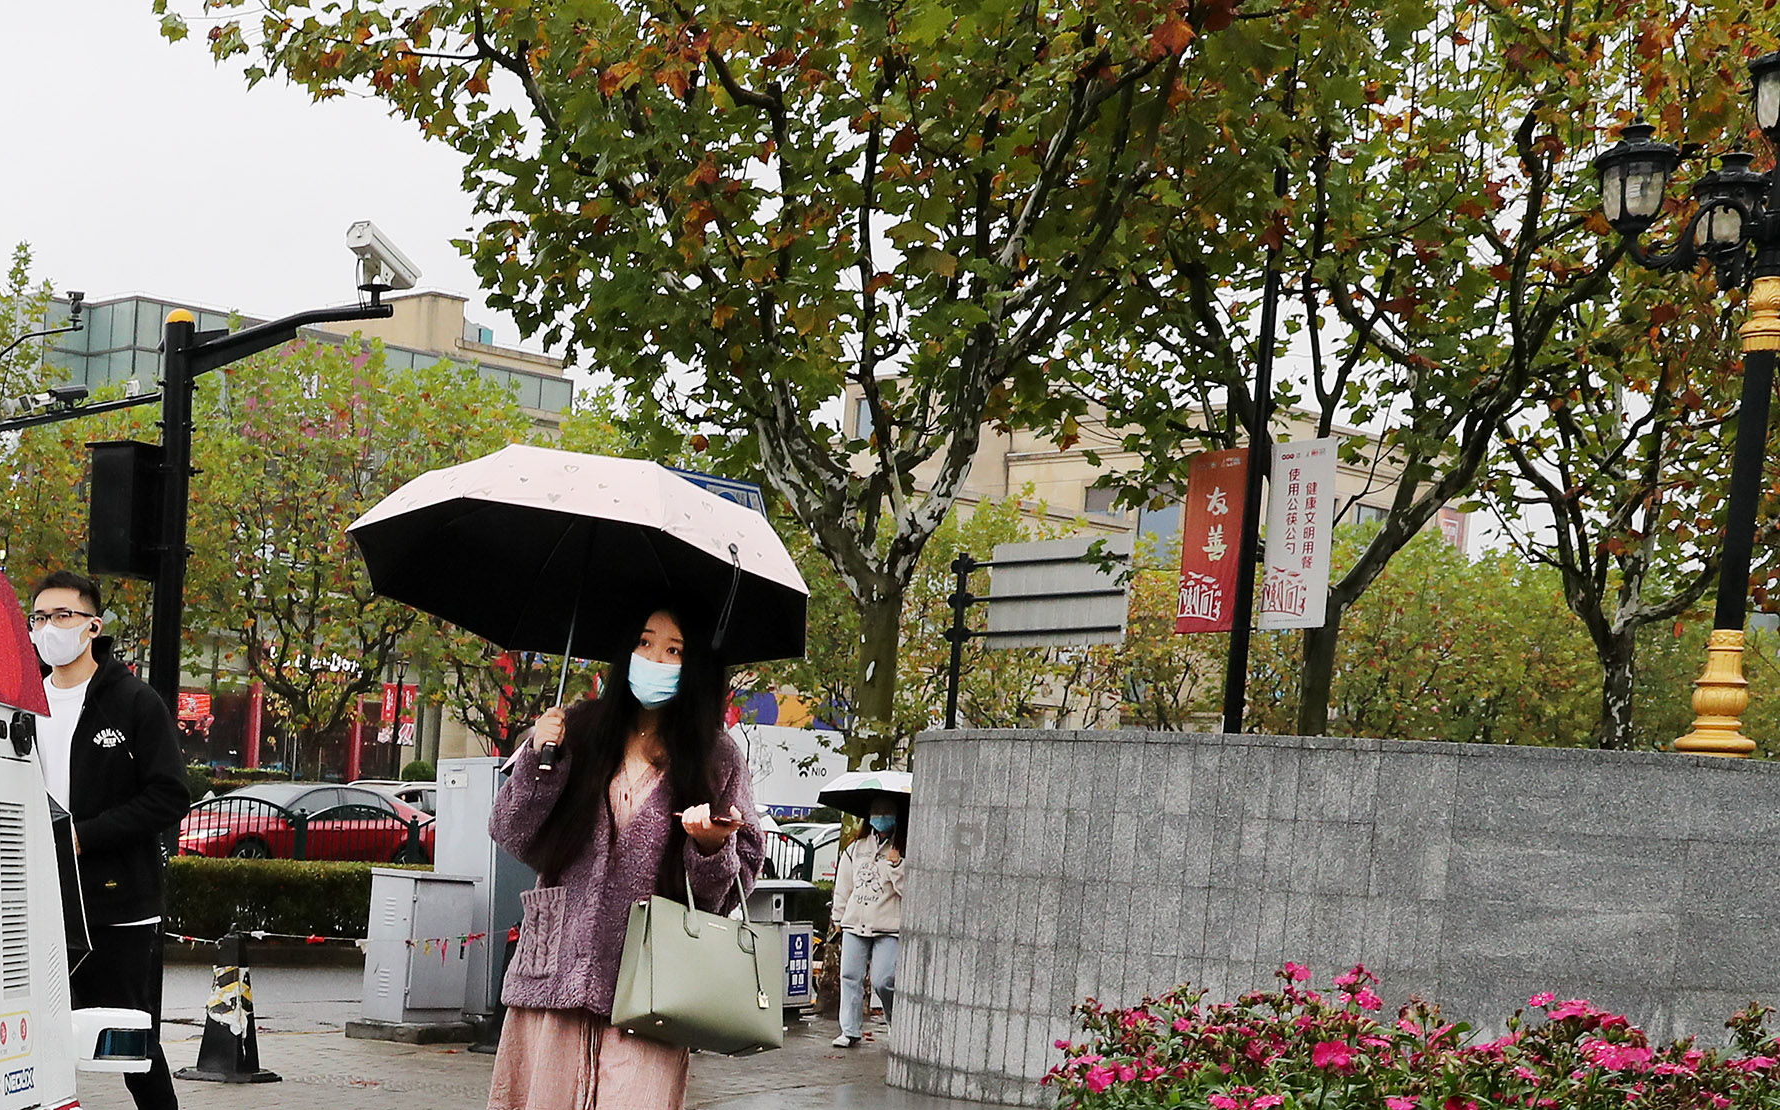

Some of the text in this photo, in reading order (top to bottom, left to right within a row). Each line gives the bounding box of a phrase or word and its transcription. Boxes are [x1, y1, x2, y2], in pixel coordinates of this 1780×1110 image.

[1202, 486, 1229, 562] 友善
[1284, 468, 1301, 555] 使用公筷公勺
[1301, 481, 1318, 569] 健康文明用餐
[811, 767, 827, 777] NIO
